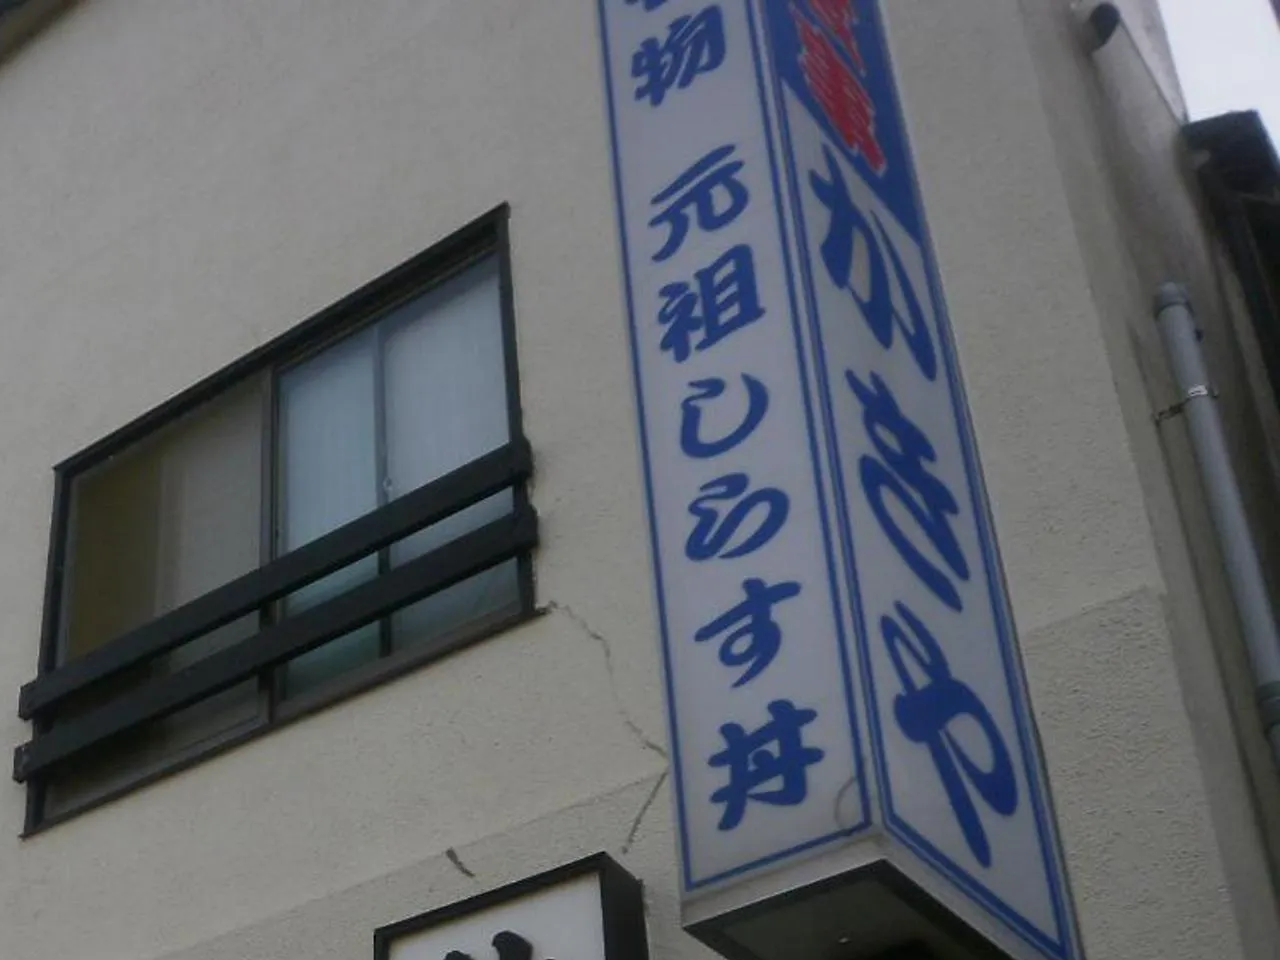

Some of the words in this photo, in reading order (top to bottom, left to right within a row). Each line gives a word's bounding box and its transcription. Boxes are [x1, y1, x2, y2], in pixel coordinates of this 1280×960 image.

[648, 144, 824, 831] 元祖しらす丼
[808, 142, 1018, 868] かきや
